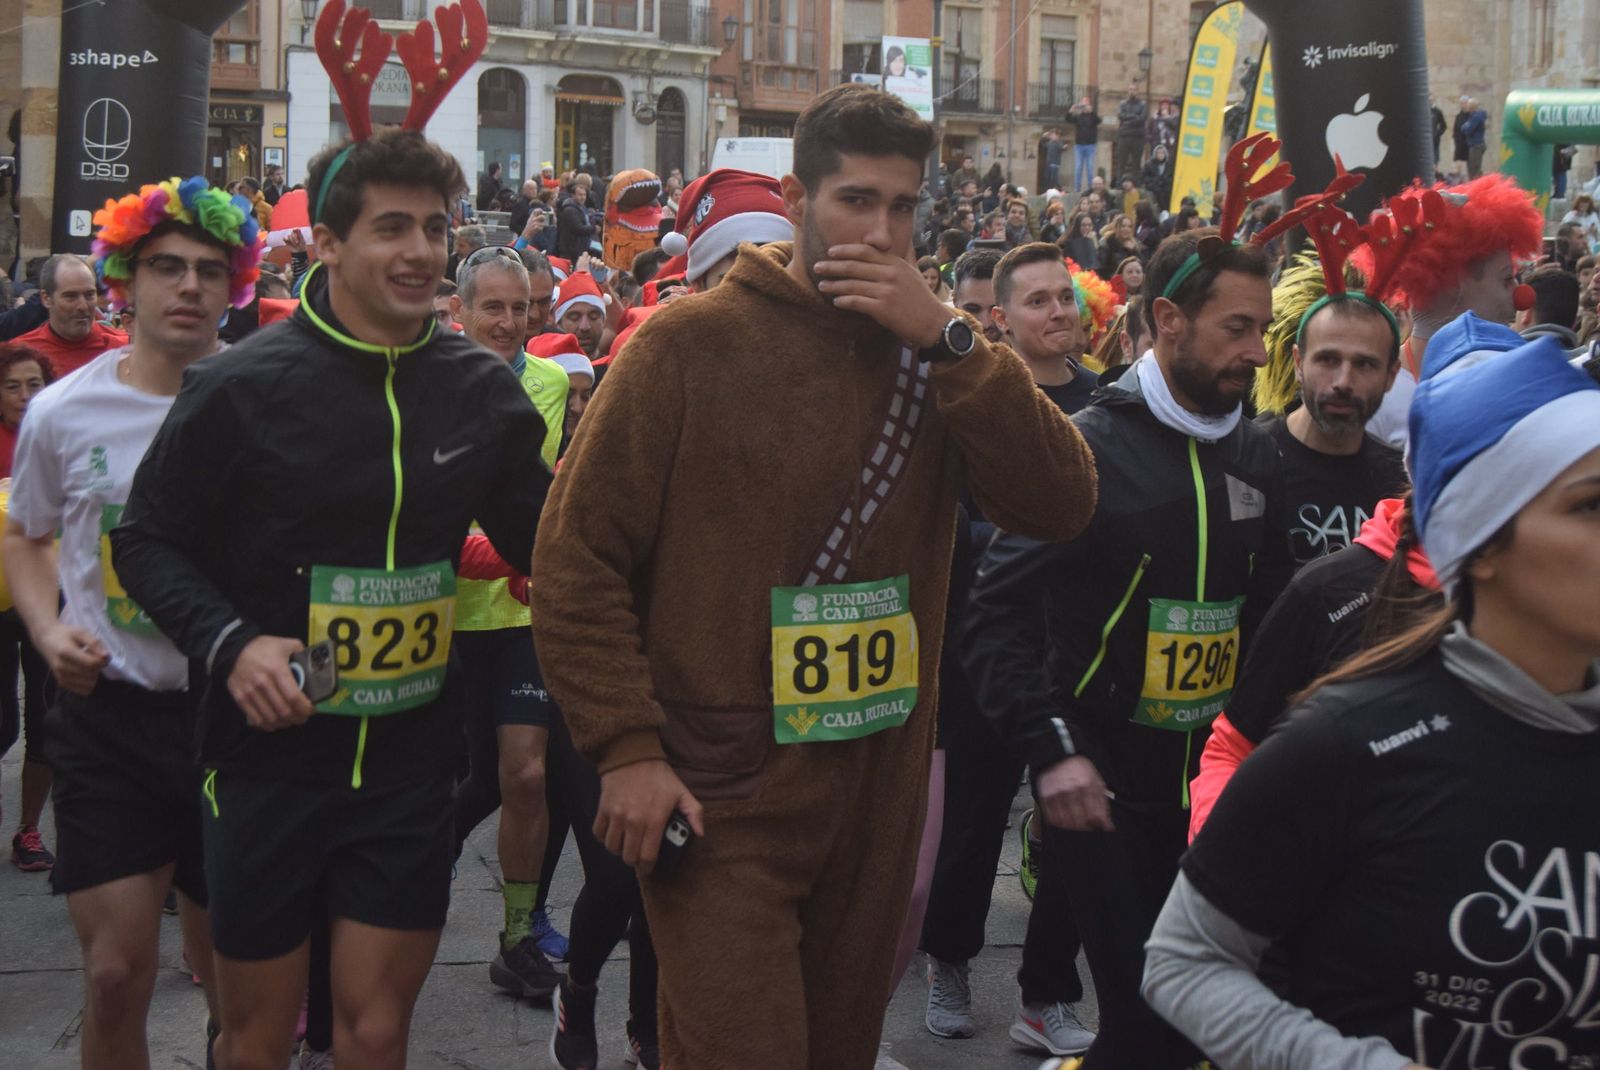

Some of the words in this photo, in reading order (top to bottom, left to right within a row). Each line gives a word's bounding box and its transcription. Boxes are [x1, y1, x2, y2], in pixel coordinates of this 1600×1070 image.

[69, 48, 142, 70] 3shape
[1326, 41, 1395, 60] invisalign
[1566, 103, 1600, 127] RURA
[81, 161, 130, 178] DSD
[359, 590, 395, 605] CAJA
[399, 584, 441, 604] RURAL
[822, 606, 860, 621] CAJA
[863, 600, 902, 618] RURAL
[1328, 592, 1369, 623] luanvi
[327, 611, 439, 672] 823
[792, 629, 896, 695] 819
[1160, 638, 1235, 692] 1296
[353, 688, 395, 706] CAJA
[398, 676, 440, 697] RURAL
[822, 711, 863, 728] CAJA
[865, 699, 909, 723] RURAL
[1369, 719, 1430, 756] luanvi
[1414, 970, 1440, 987] 31
[1448, 975, 1496, 994] DIC.
[1425, 989, 1481, 1013] 2022
